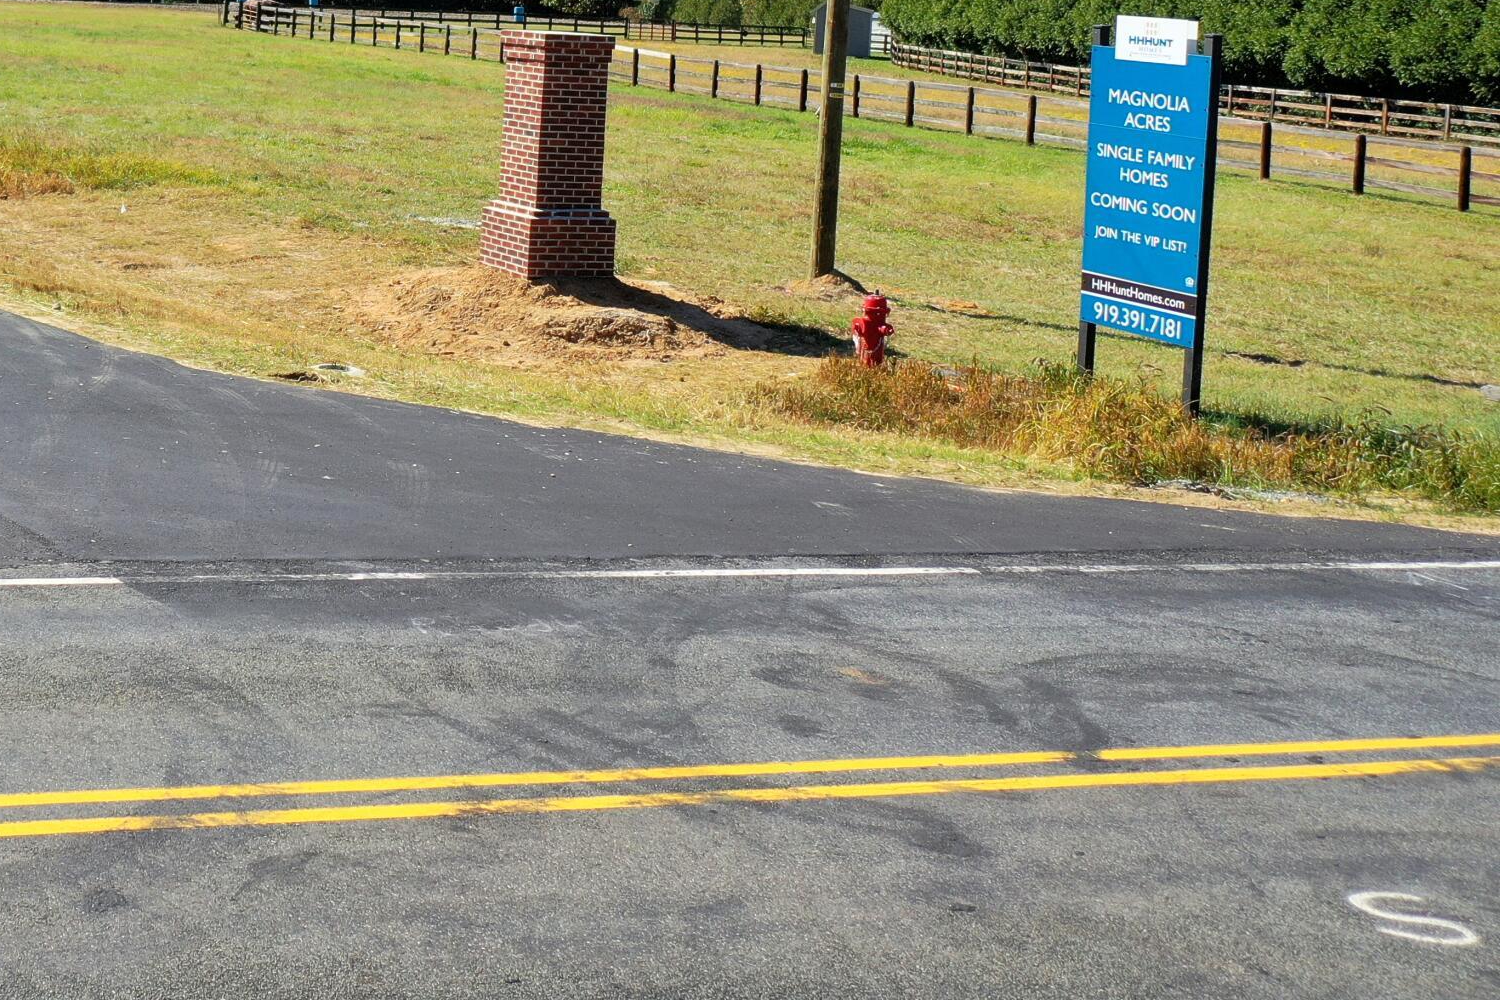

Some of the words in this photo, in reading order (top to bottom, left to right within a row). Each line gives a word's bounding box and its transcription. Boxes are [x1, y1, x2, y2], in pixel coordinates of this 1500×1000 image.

[1128, 35, 1174, 47] HHHUNT
[1108, 88, 1190, 113] MAGNOLIA
[1124, 112, 1171, 133] ACRES
[1096, 142, 1143, 163] SINGLE
[1147, 150, 1195, 171] FAMILY
[1119, 167, 1169, 189] HOMES
[1090, 192, 1147, 215] COMING
[1151, 202, 1196, 223] SOON
[1094, 225, 1118, 240] JOIN
[1121, 230, 1141, 244] THE
[1144, 233, 1160, 248] VIP
[1162, 238, 1187, 253] LIST!
[1091, 278, 1185, 310] HHHuntHomes.com
[1093, 301, 1181, 339] 919.391.7181
